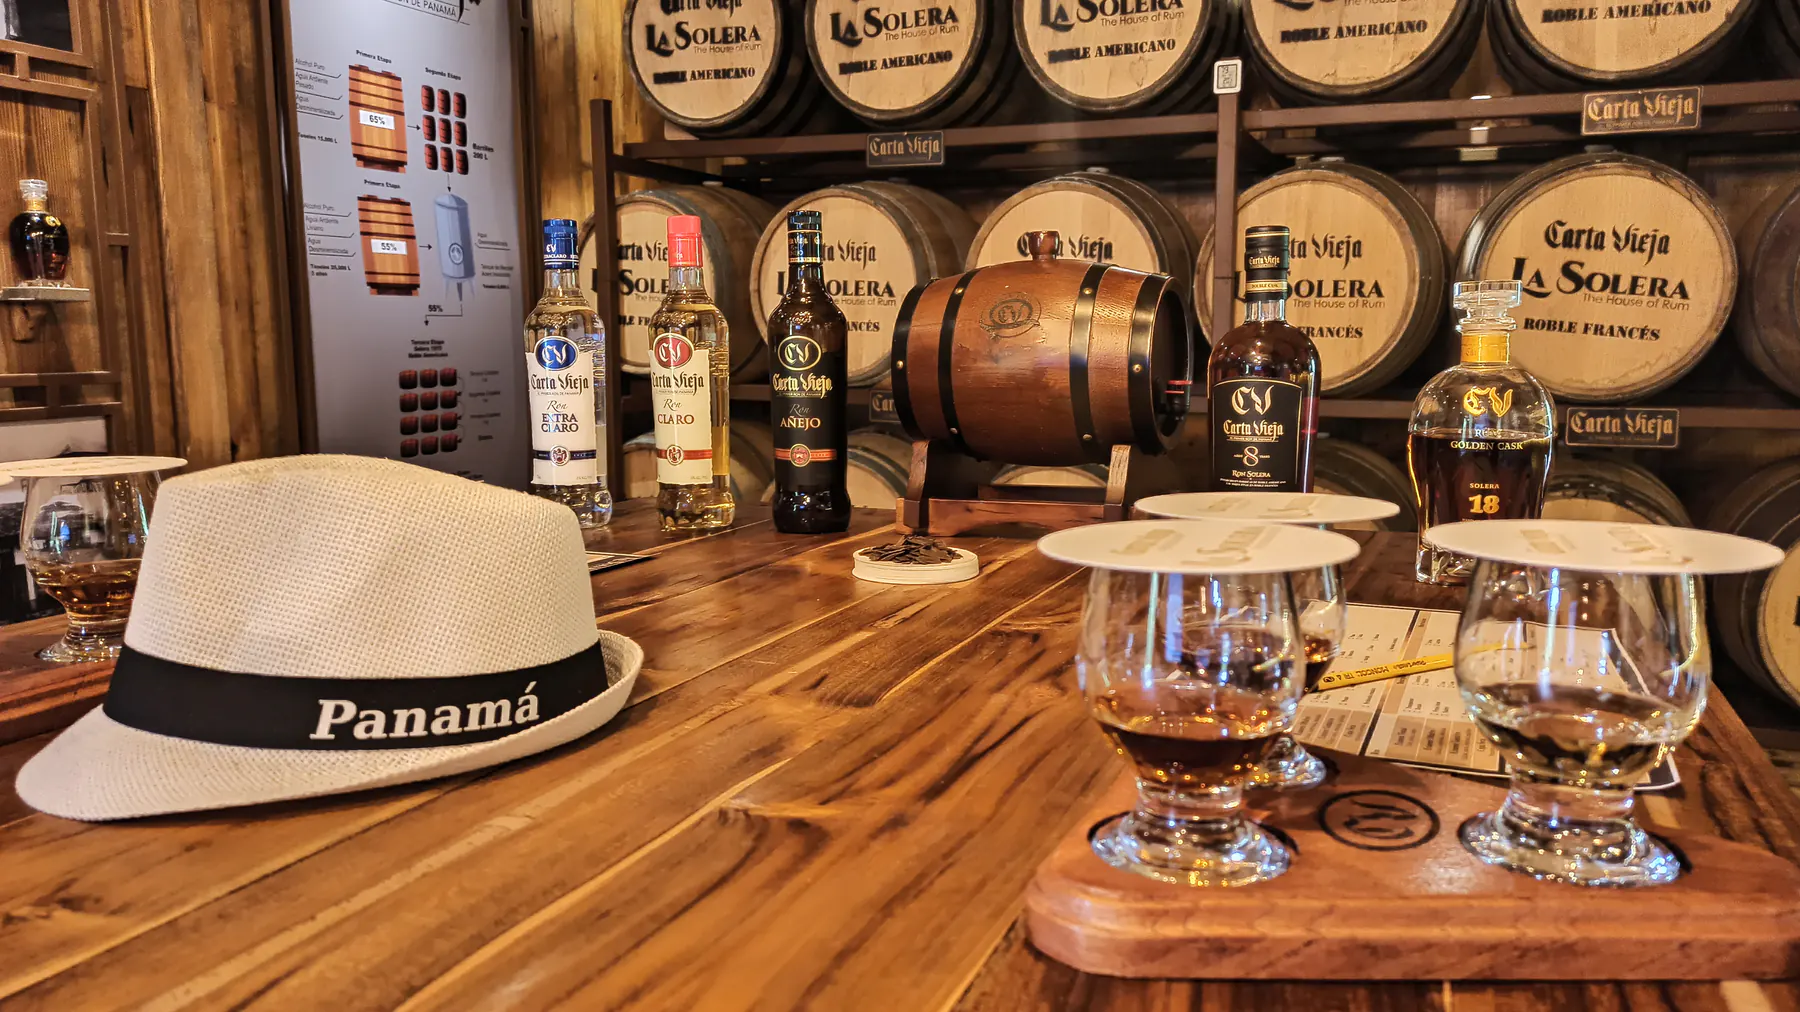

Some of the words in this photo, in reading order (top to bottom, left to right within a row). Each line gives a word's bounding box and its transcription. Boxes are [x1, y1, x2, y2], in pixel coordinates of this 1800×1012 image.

[423, 1, 457, 17] PANAMÁ
[1101, 18, 1117, 27] The
[1119, 15, 1148, 26] House
[1151, 13, 1161, 22] of
[1163, 10, 1184, 20] Rum
[1541, 7, 1598, 23] ROBLE
[1603, 0, 1712, 19] AMERICANO
[863, 5, 959, 38] SOLERA
[1333, 19, 1428, 39] AMERICANO
[675, 21, 761, 50] SOLERA
[885, 32, 899, 41] The
[901, 28, 927, 39] House
[929, 27, 939, 35] of
[940, 24, 960, 34] Rum
[356, 49, 376, 60] Primera
[694, 45, 708, 54] The
[709, 43, 735, 53] House
[745, 42, 762, 52] Rum
[1094, 38, 1176, 58] AMERICANO
[880, 50, 953, 70] AMERICANO
[690, 66, 756, 81] AMERICANO
[1588, 97, 1641, 121] Carta
[1643, 92, 1695, 125] Vieja
[369, 114, 386, 125] 65%
[869, 137, 905, 156] Carta
[906, 136, 940, 160] Vieja
[380, 242, 398, 252] 55%
[645, 240, 668, 261] Vie
[1069, 233, 1113, 263] Vieja
[1312, 232, 1363, 270] Vieja
[1544, 219, 1606, 251] Carta
[1611, 223, 1670, 266] Vieja
[838, 238, 877, 270] Vieja
[619, 269, 669, 296] SOLE
[826, 279, 896, 298] OLERA
[1288, 278, 1385, 299] OLERA
[1556, 260, 1690, 300] SOLERA
[428, 304, 443, 313] 55%
[1293, 298, 1310, 309] The
[1313, 299, 1345, 310] House
[1348, 299, 1359, 309] of
[1361, 299, 1385, 310] Rum
[1583, 292, 1603, 304] The
[1606, 295, 1643, 307] House
[1647, 297, 1660, 308] of
[1662, 299, 1690, 312] Rum
[1523, 317, 1578, 334] ROBLE
[1582, 321, 1661, 341] FRANCÉS
[541, 342, 568, 365] CV
[658, 341, 682, 363] CV
[785, 342, 811, 364] CV
[530, 373, 557, 390] Carta
[558, 372, 589, 395] Vieja
[673, 370, 705, 396] Vieja
[772, 373, 799, 391] Carta
[800, 372, 833, 399] Vieja
[546, 399, 568, 413] Ron
[789, 403, 811, 417] Ron
[1231, 384, 1275, 415] CV
[1463, 386, 1513, 418] CV
[541, 423, 579, 433] CLARO
[542, 413, 578, 423] EXTRA
[657, 413, 695, 425] CLARO
[780, 415, 821, 431] AÑEJO
[1570, 411, 1622, 434] Carta
[1623, 411, 1673, 443] Vieja
[1223, 419, 1252, 435] Carta
[1253, 419, 1284, 442] Vieja
[1242, 445, 1259, 467] 8
[1450, 440, 1495, 451] GOLDEN
[1497, 441, 1524, 451] CASK
[1468, 494, 1500, 514] 18
[309, 681, 540, 740] Panamá
